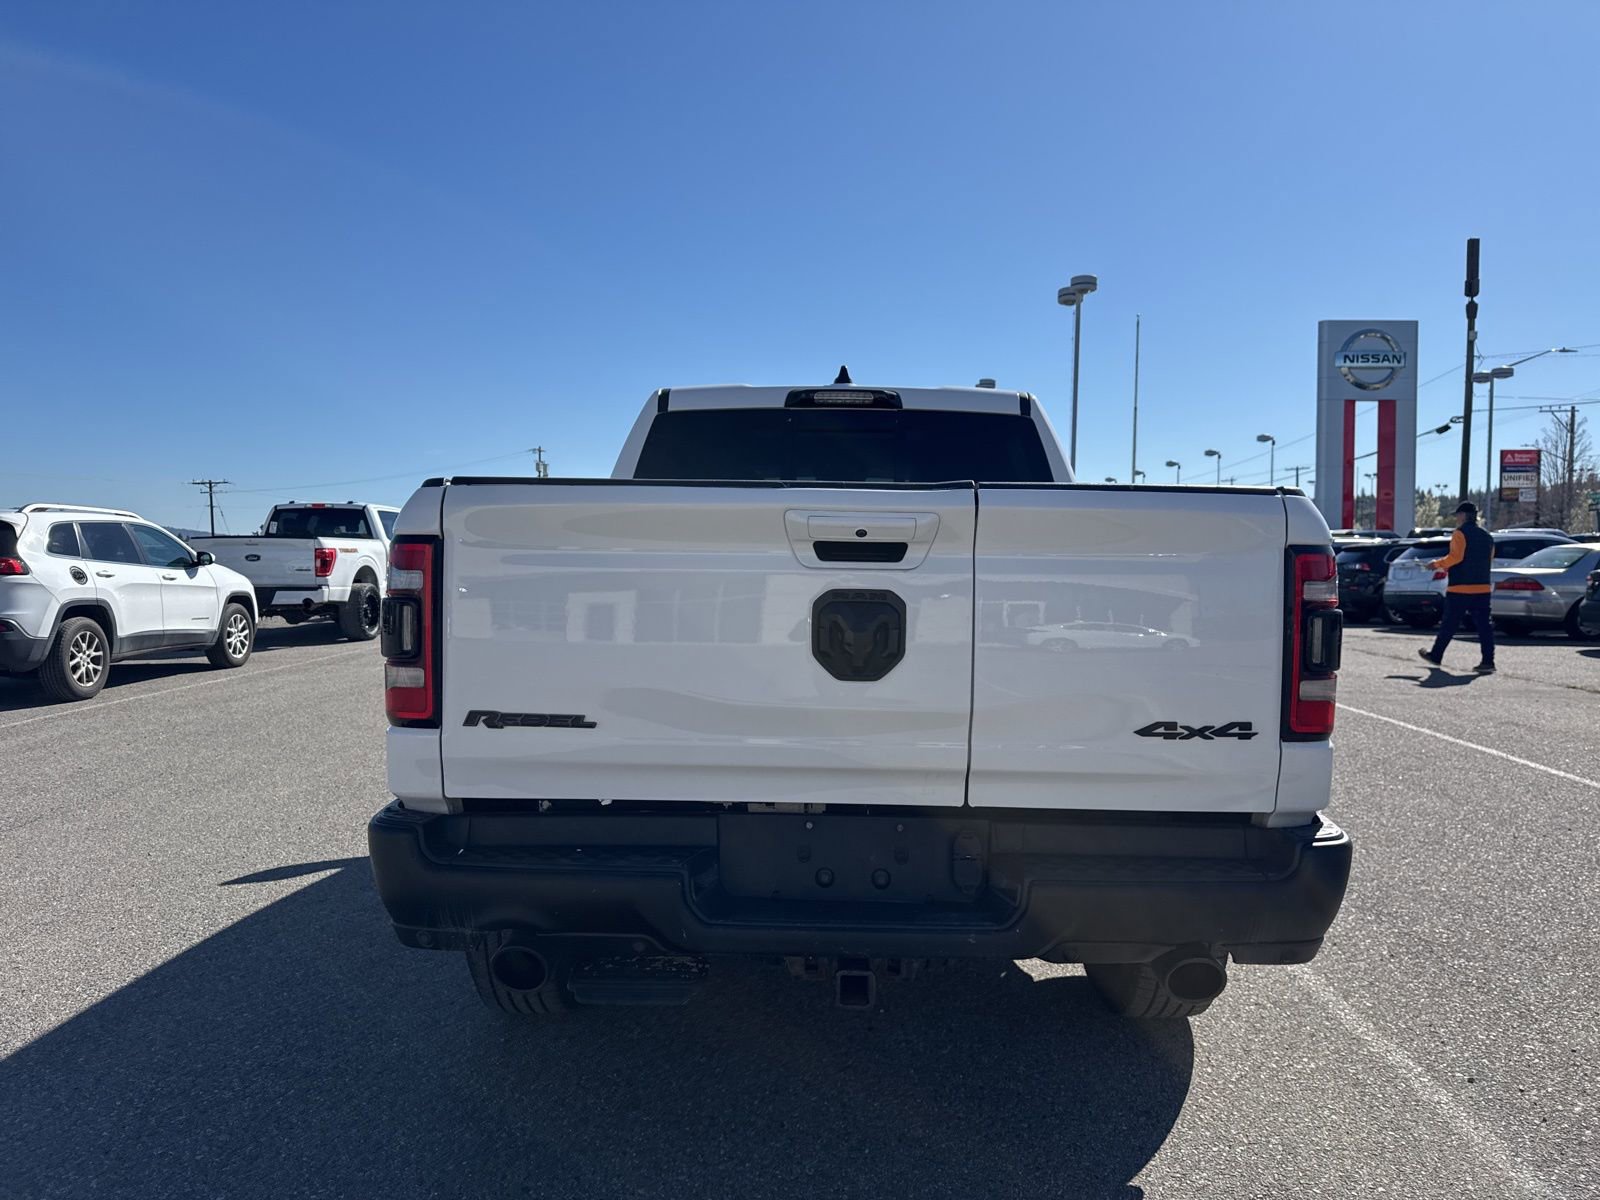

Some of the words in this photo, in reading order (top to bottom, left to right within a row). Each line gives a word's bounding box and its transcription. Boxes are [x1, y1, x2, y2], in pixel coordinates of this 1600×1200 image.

[1343, 353, 1402, 364] NISSAN
[831, 592, 887, 600] RAM
[462, 709, 597, 729] REBEL
[1133, 721, 1259, 740] 4x4
